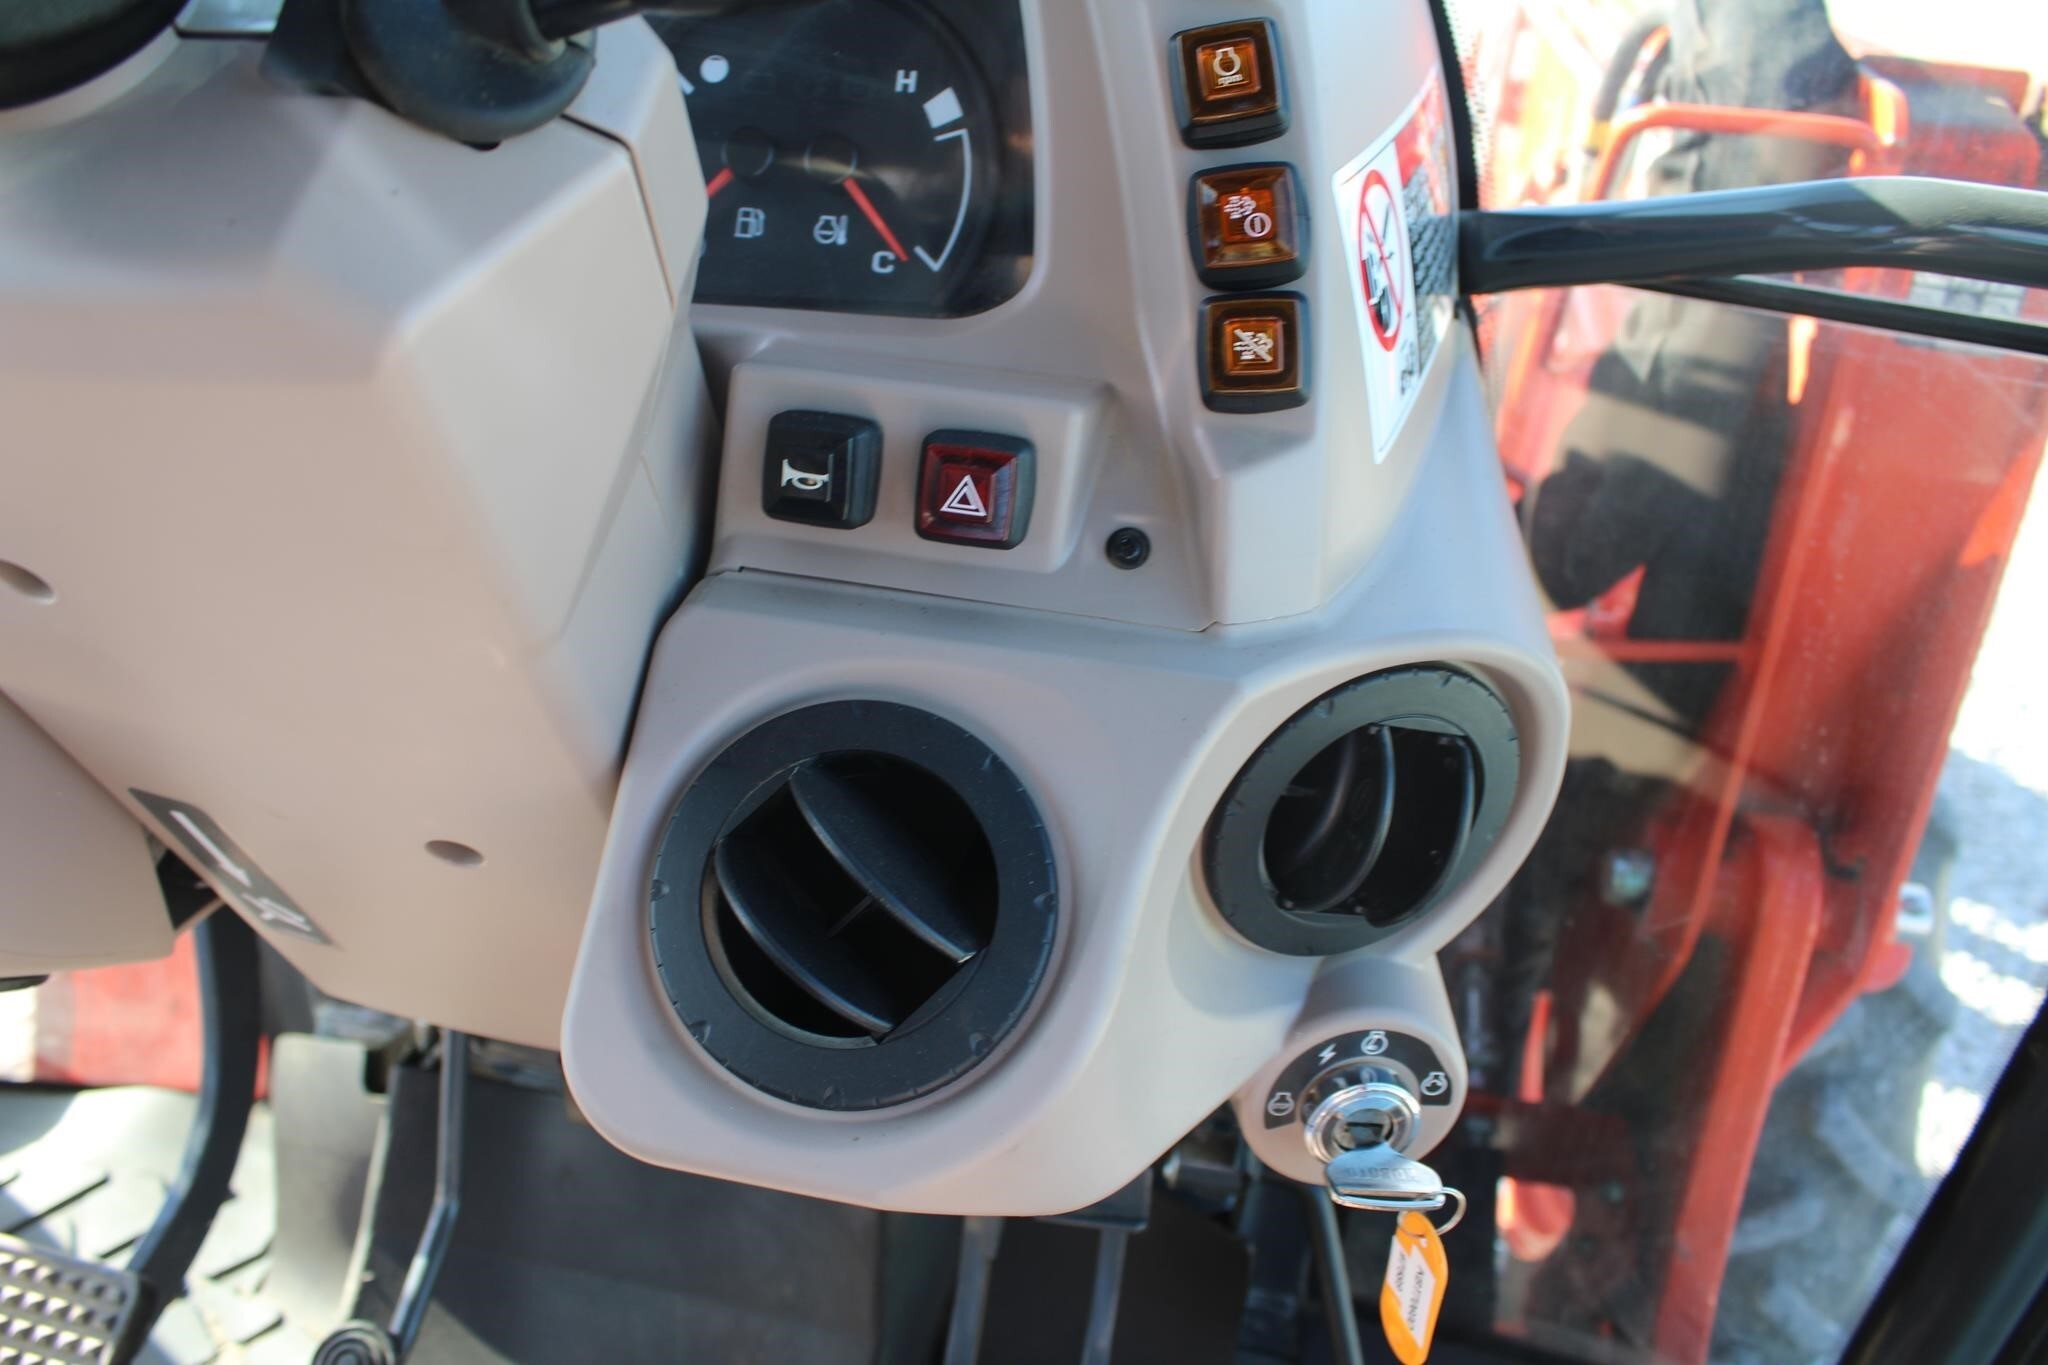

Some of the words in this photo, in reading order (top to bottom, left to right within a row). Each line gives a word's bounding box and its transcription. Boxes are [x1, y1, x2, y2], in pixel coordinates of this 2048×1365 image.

[895, 69, 918, 93] H
[1218, 74, 1243, 86] rpm
[871, 250, 896, 273] C
